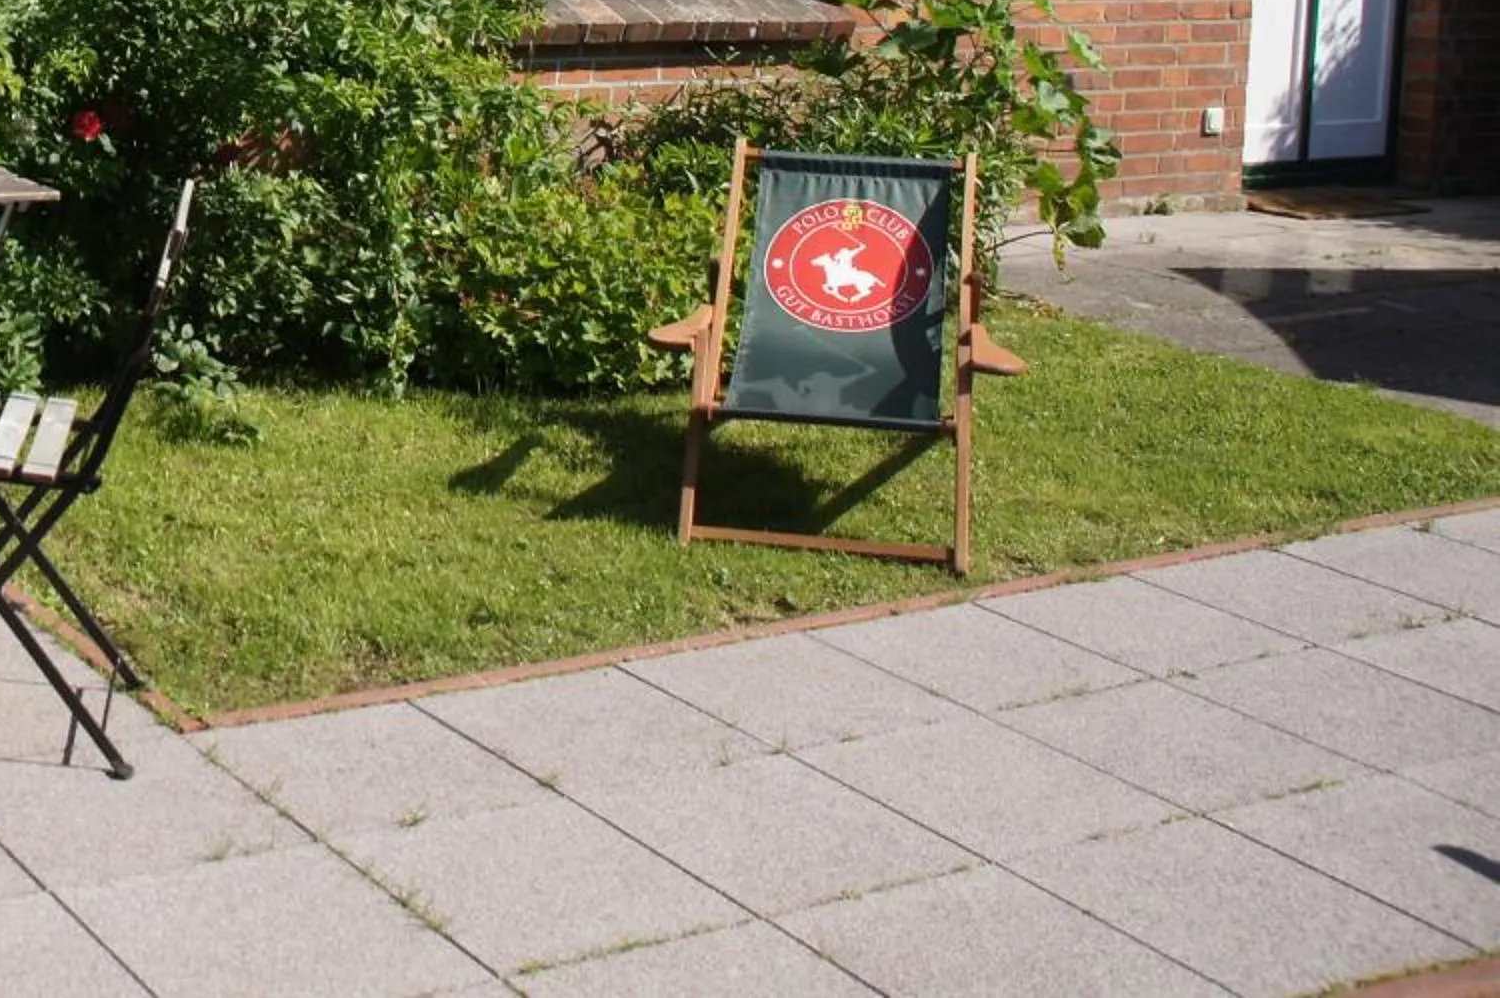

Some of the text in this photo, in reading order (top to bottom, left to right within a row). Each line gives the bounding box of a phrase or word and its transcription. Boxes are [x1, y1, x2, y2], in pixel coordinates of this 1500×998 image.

[791, 205, 908, 239] POLO CLUB
[776, 285, 808, 314] GUT
